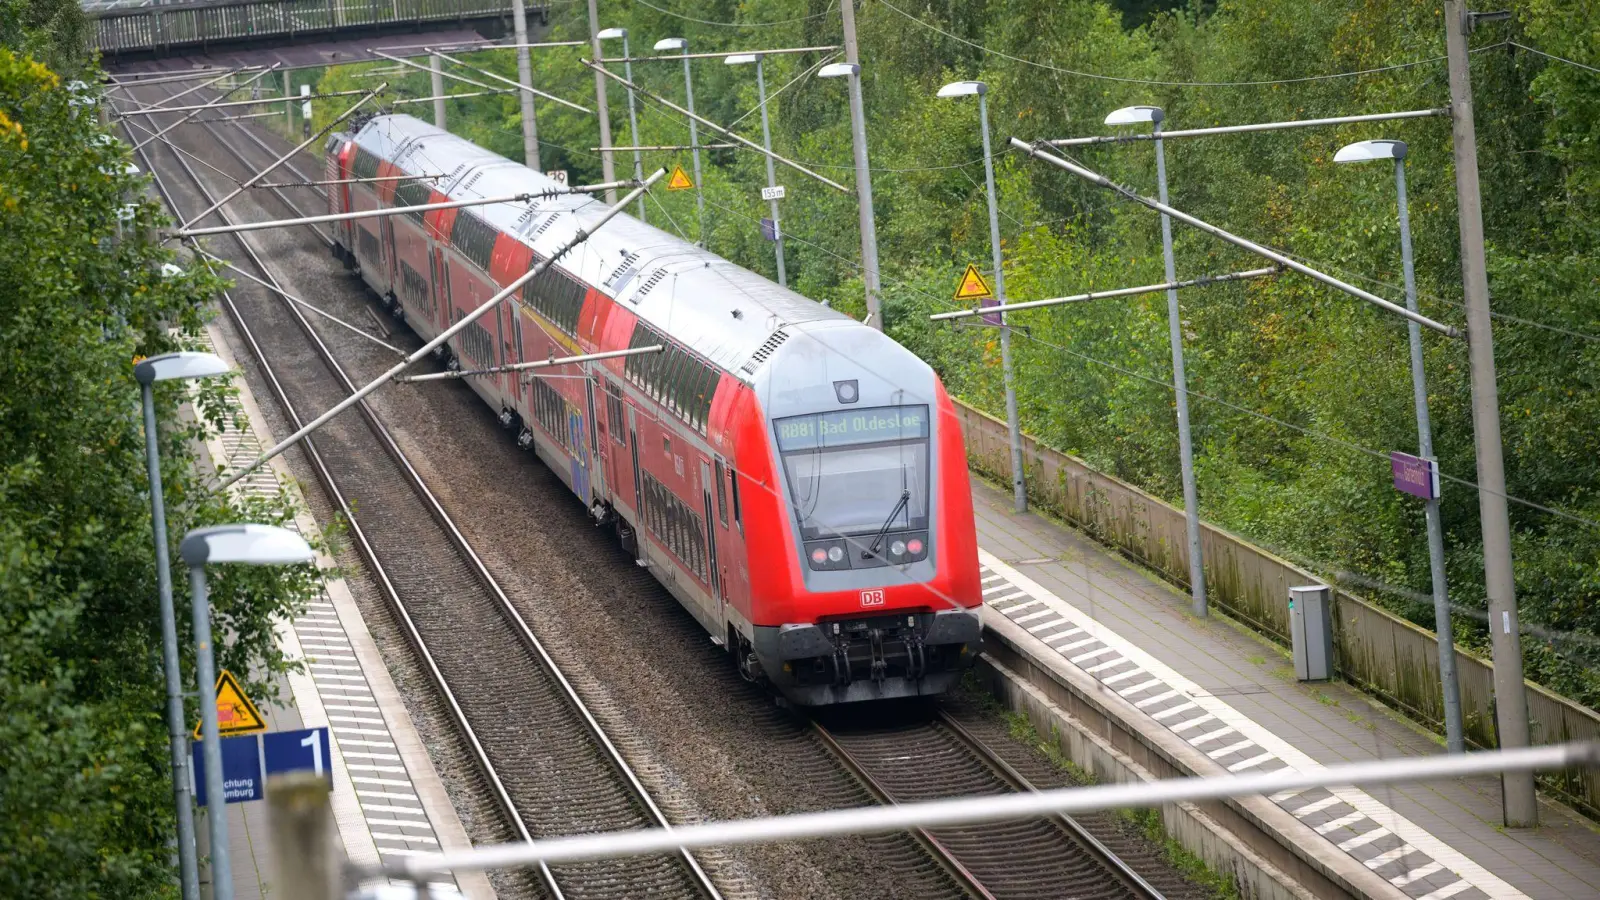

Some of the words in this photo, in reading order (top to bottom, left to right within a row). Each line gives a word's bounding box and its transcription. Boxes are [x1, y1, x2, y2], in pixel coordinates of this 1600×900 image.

[764, 189, 775, 198] 155
[780, 423, 815, 440] RB81
[820, 418, 847, 435] Bad
[853, 414, 920, 432] Oldesloe
[862, 591, 883, 605] DB
[300, 729, 324, 778] 1
[224, 778, 253, 790] chtung
[223, 787, 254, 799] amburg
